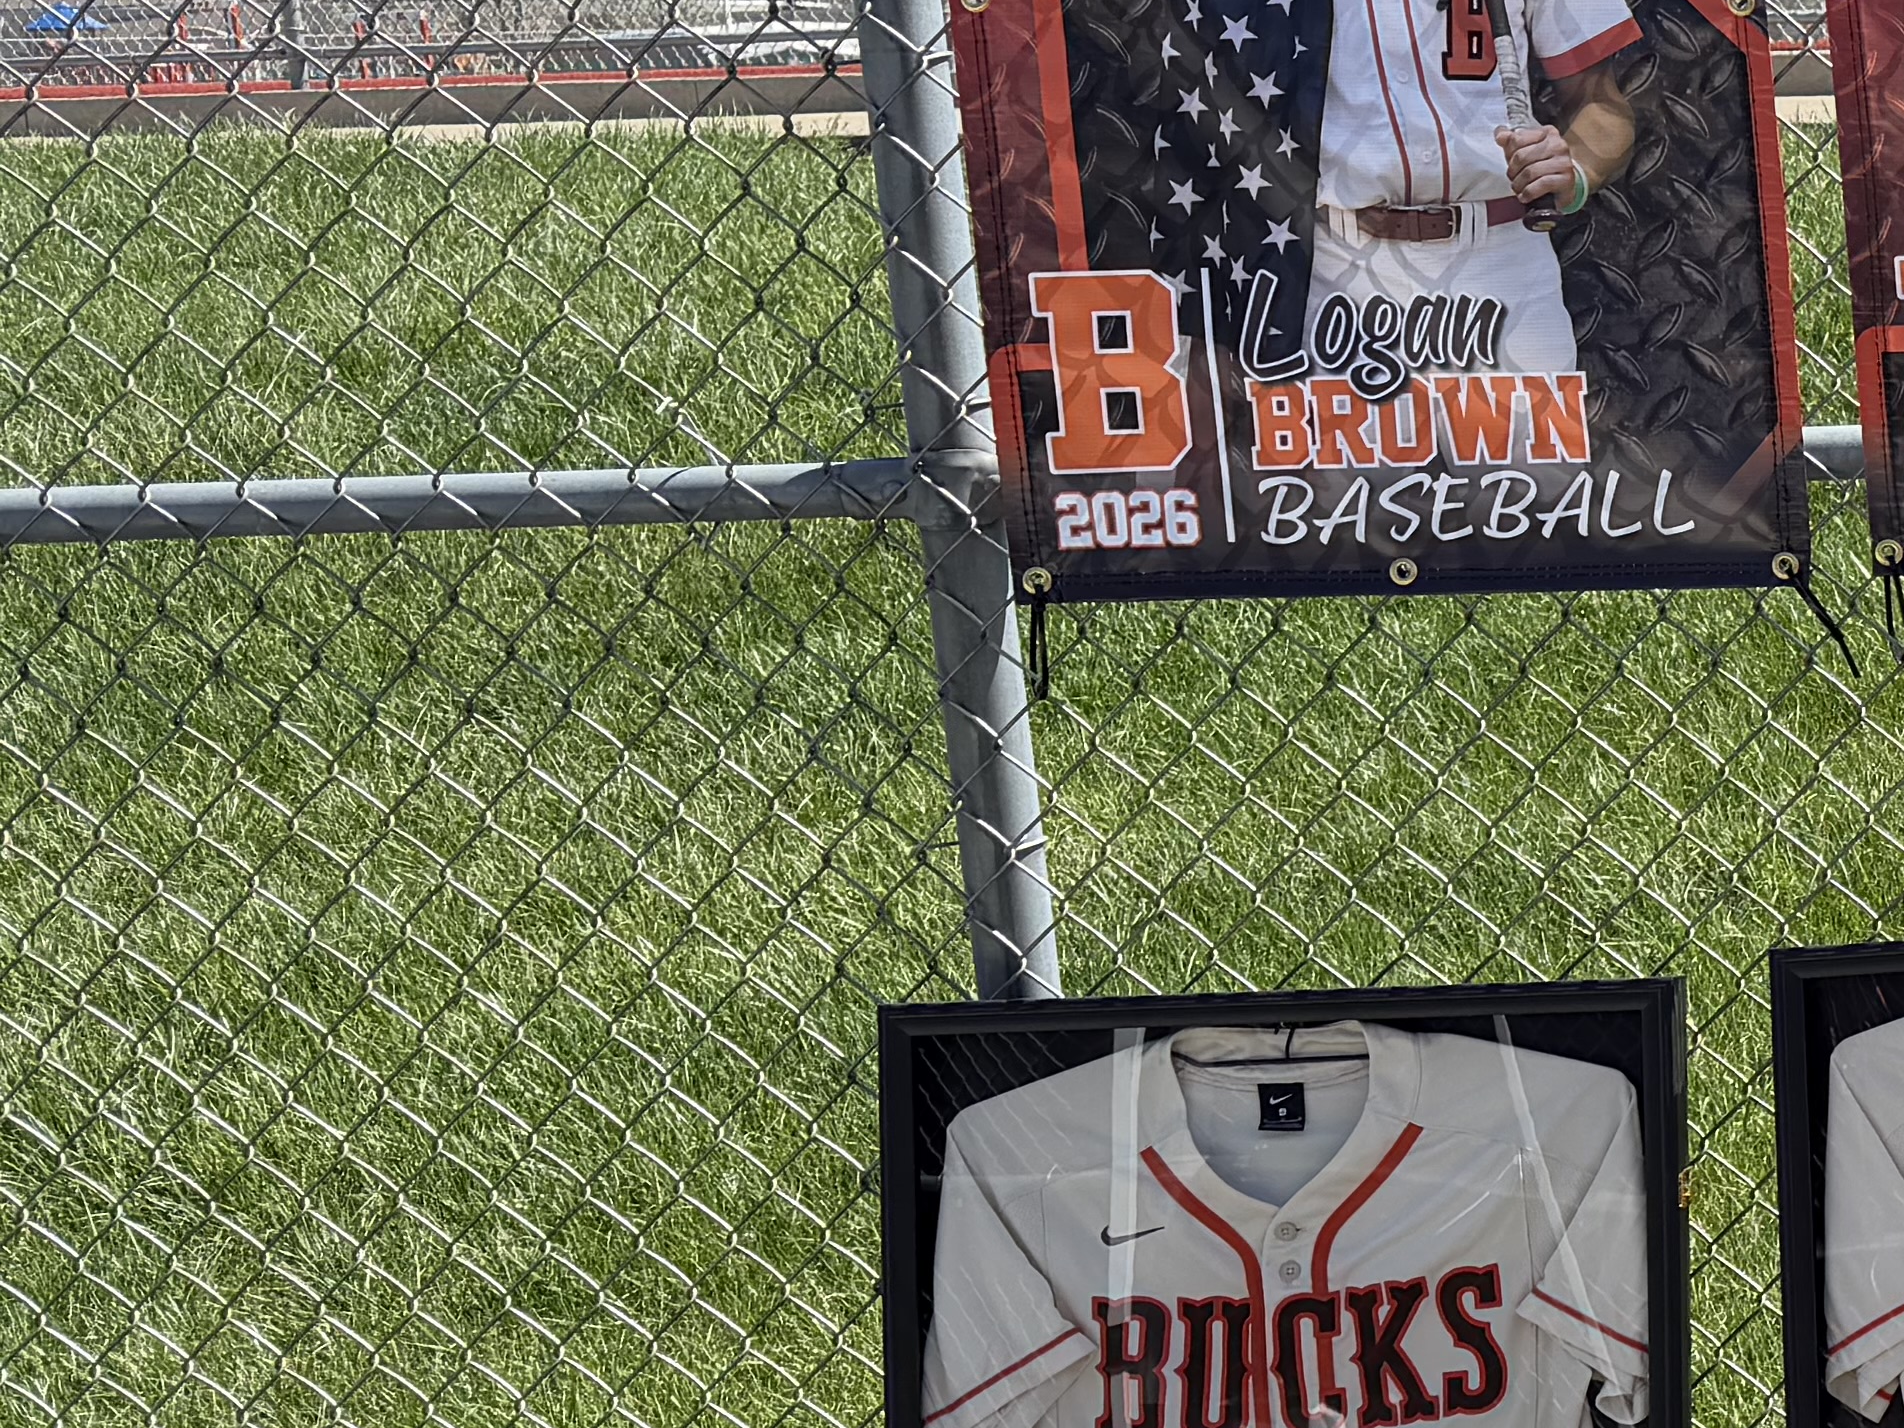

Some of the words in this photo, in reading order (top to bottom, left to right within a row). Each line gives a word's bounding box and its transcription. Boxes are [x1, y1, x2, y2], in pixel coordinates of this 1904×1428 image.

[1029, 269, 1194, 474] B
[1238, 268, 1507, 400] Logan
[1244, 371, 1591, 471] BROWN
[1057, 490, 1201, 550] 2026
[1257, 469, 1696, 547] BASEBALL
